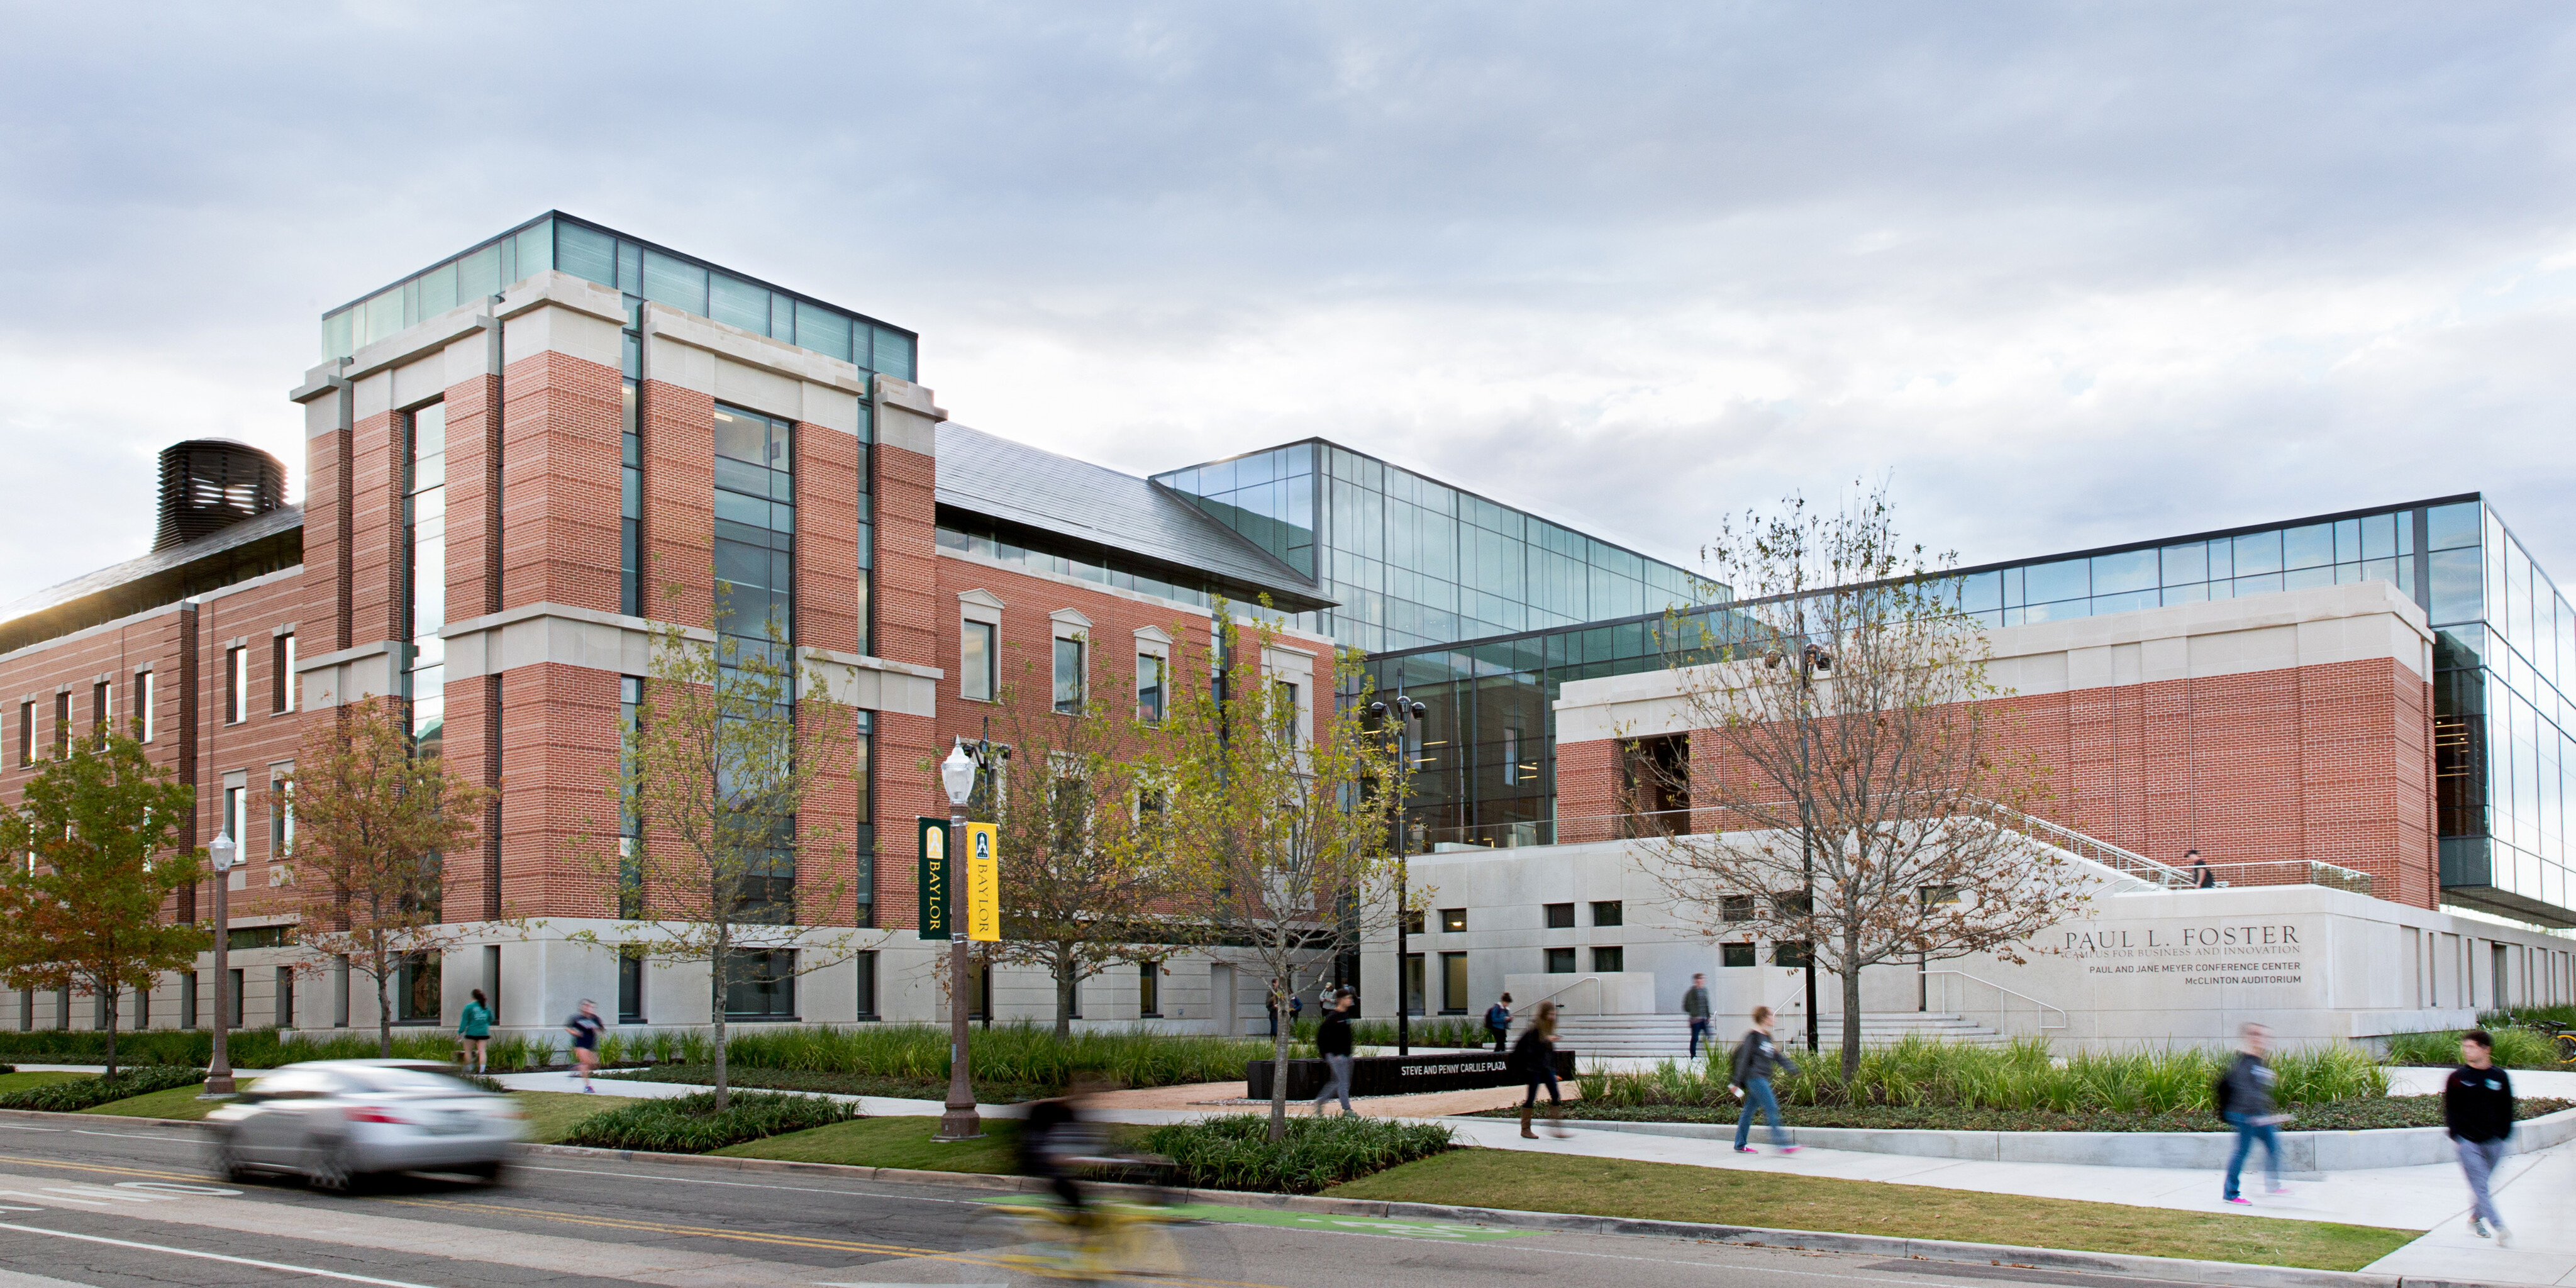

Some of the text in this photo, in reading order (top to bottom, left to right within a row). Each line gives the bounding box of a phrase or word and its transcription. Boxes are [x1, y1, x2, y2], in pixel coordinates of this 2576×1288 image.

[930, 861, 940, 931] BAYLOR
[978, 864, 989, 933] BAYLOR
[2064, 925, 2299, 949] PAUL L. FOSTER
[2113, 949, 2134, 958] FOR
[2138, 948, 2190, 957] BUSINESS
[2195, 947, 2219, 956] AND
[2224, 945, 2300, 955] INNOVATION
[2136, 965, 2159, 973] JANE
[2162, 964, 2193, 972] MEYER
[2196, 963, 2259, 972] CONFERENCE
[2262, 962, 2301, 970] CENTER
[2185, 975, 2301, 985] McCLINTON AUDITORIUM
[1401, 1061, 1507, 1075] STEVE AND PENNY CARLILE PLAZA
